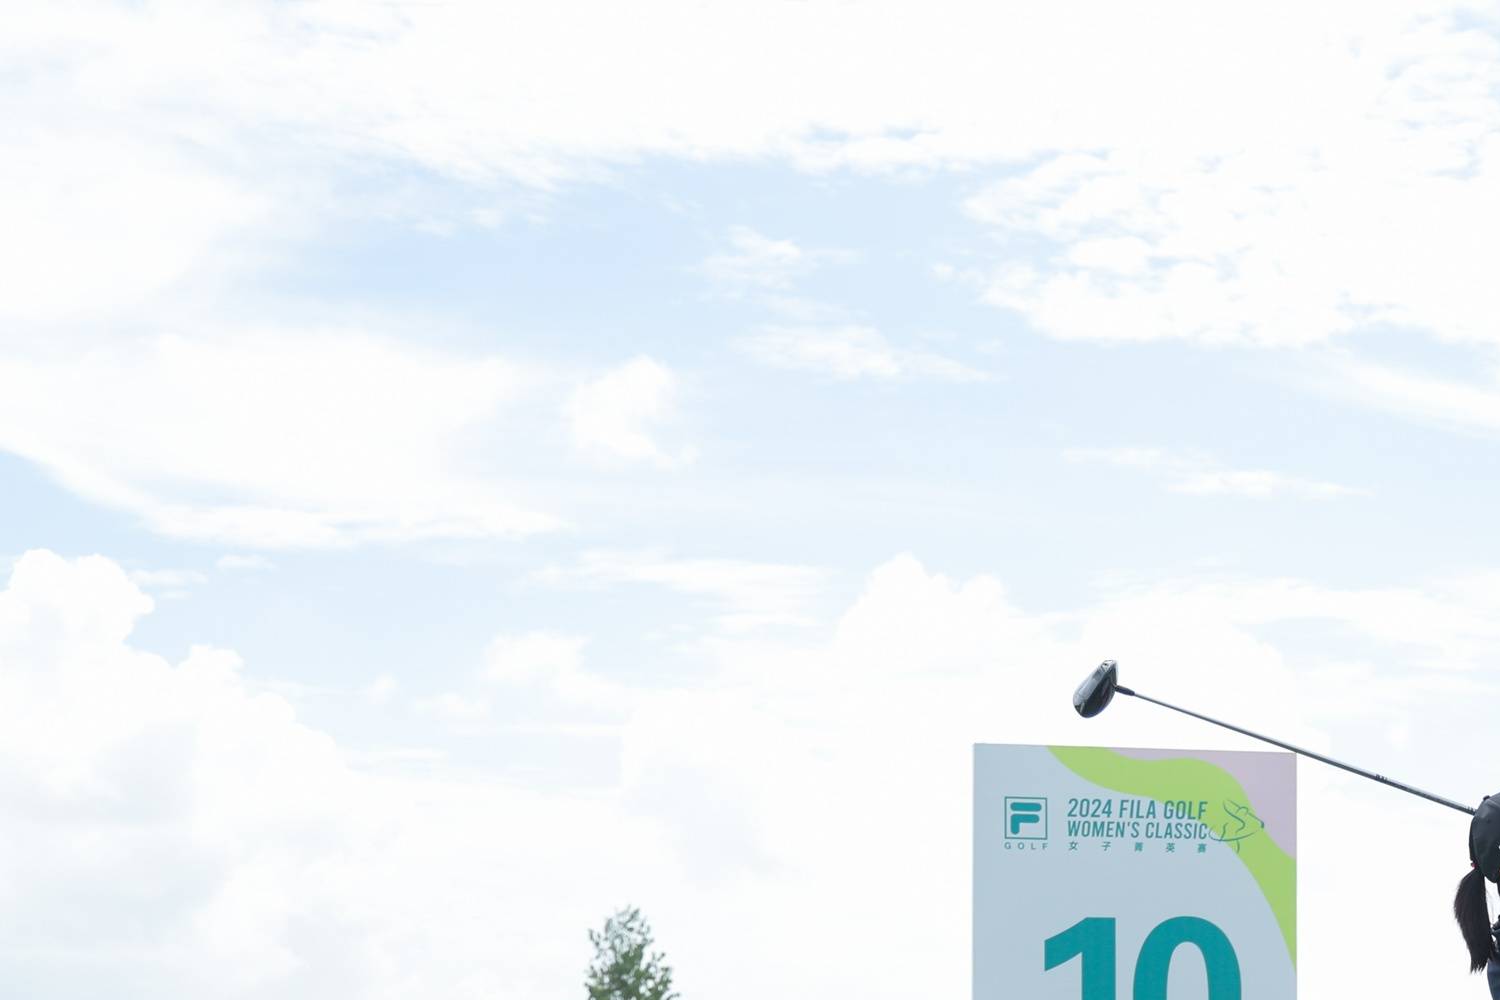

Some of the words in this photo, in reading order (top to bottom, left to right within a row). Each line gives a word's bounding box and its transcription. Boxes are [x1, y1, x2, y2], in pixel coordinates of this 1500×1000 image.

[1067, 798, 1112, 818] 2024
[1119, 800, 1157, 818] FILA
[1163, 801, 1208, 820] GOLF
[1067, 819, 1140, 838] WOMEN'S
[1145, 822, 1208, 839] CLASSIC
[1004, 841, 1048, 850] GOLF
